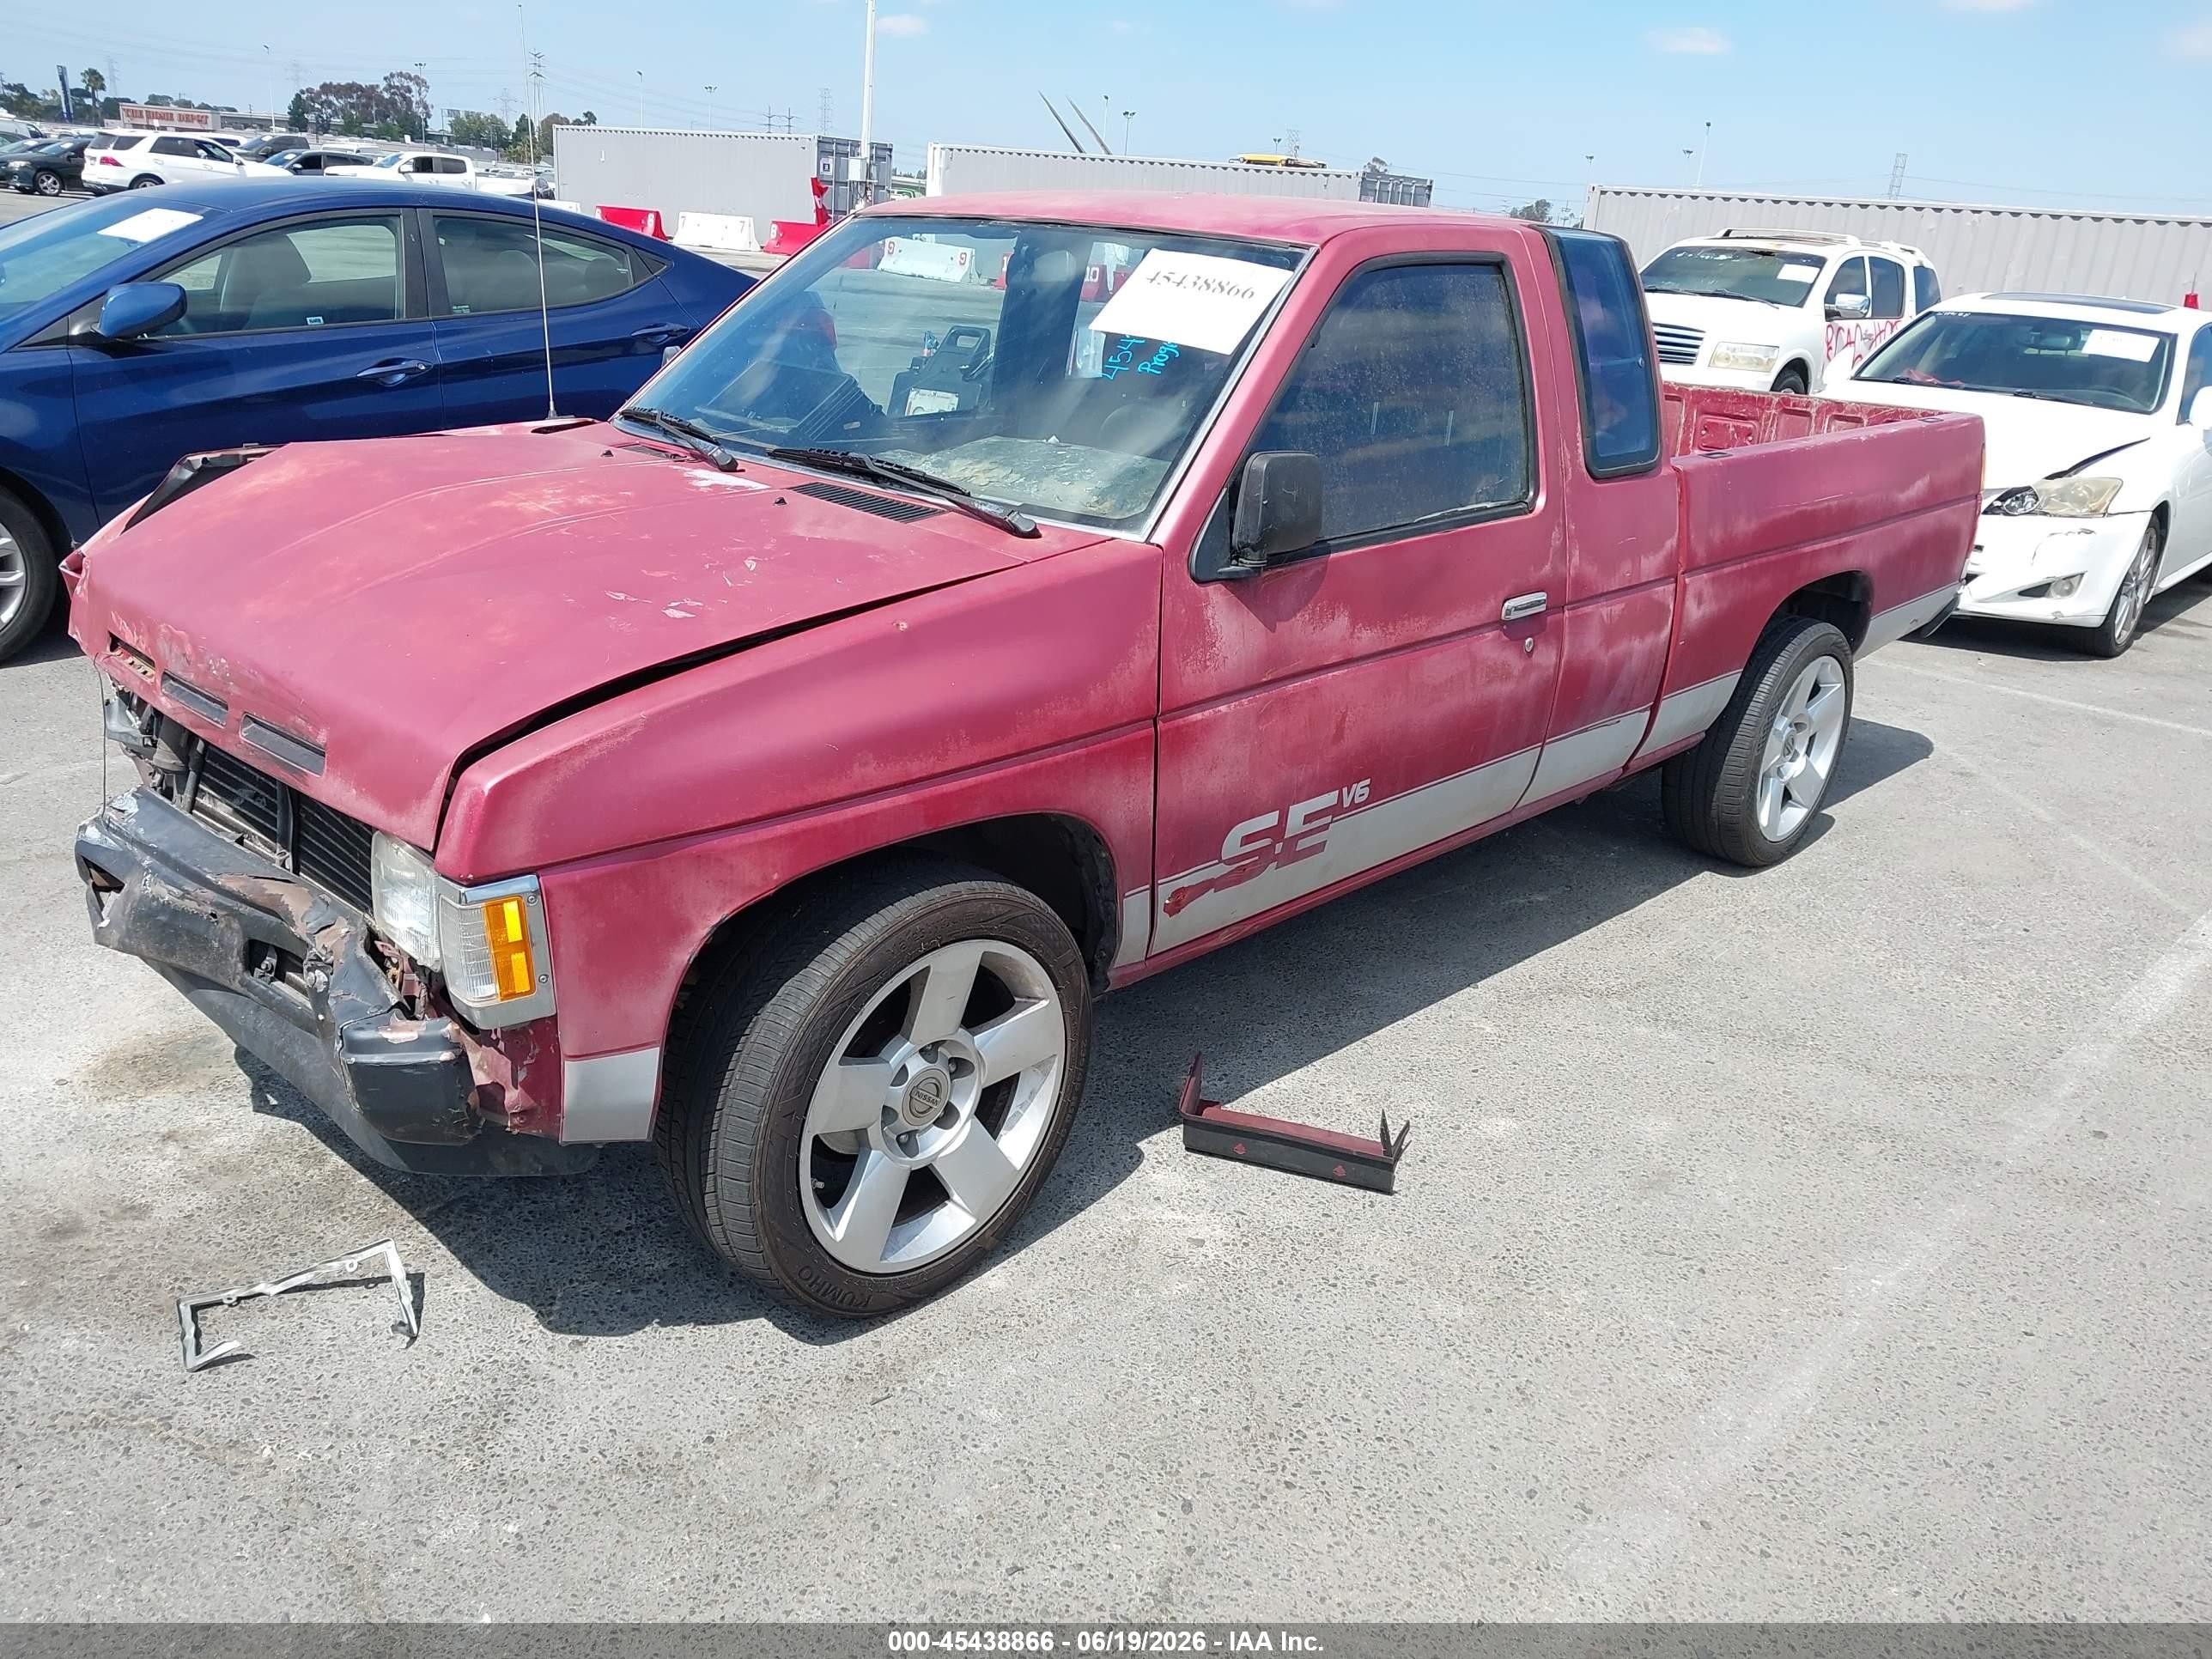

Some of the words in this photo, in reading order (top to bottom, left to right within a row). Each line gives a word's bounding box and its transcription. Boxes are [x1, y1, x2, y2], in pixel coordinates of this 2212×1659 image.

[680, 216, 686, 228] 7
[738, 221, 746, 234] 7
[887, 240, 896, 255] 9
[958, 252, 968, 266] 9
[1085, 266, 1100, 283] 10
[1146, 270, 1255, 300] 45438866
[1342, 778, 1371, 808] V6
[915, 1091, 940, 1107] NISSAN
[797, 1265, 874, 1306] KUMHO
